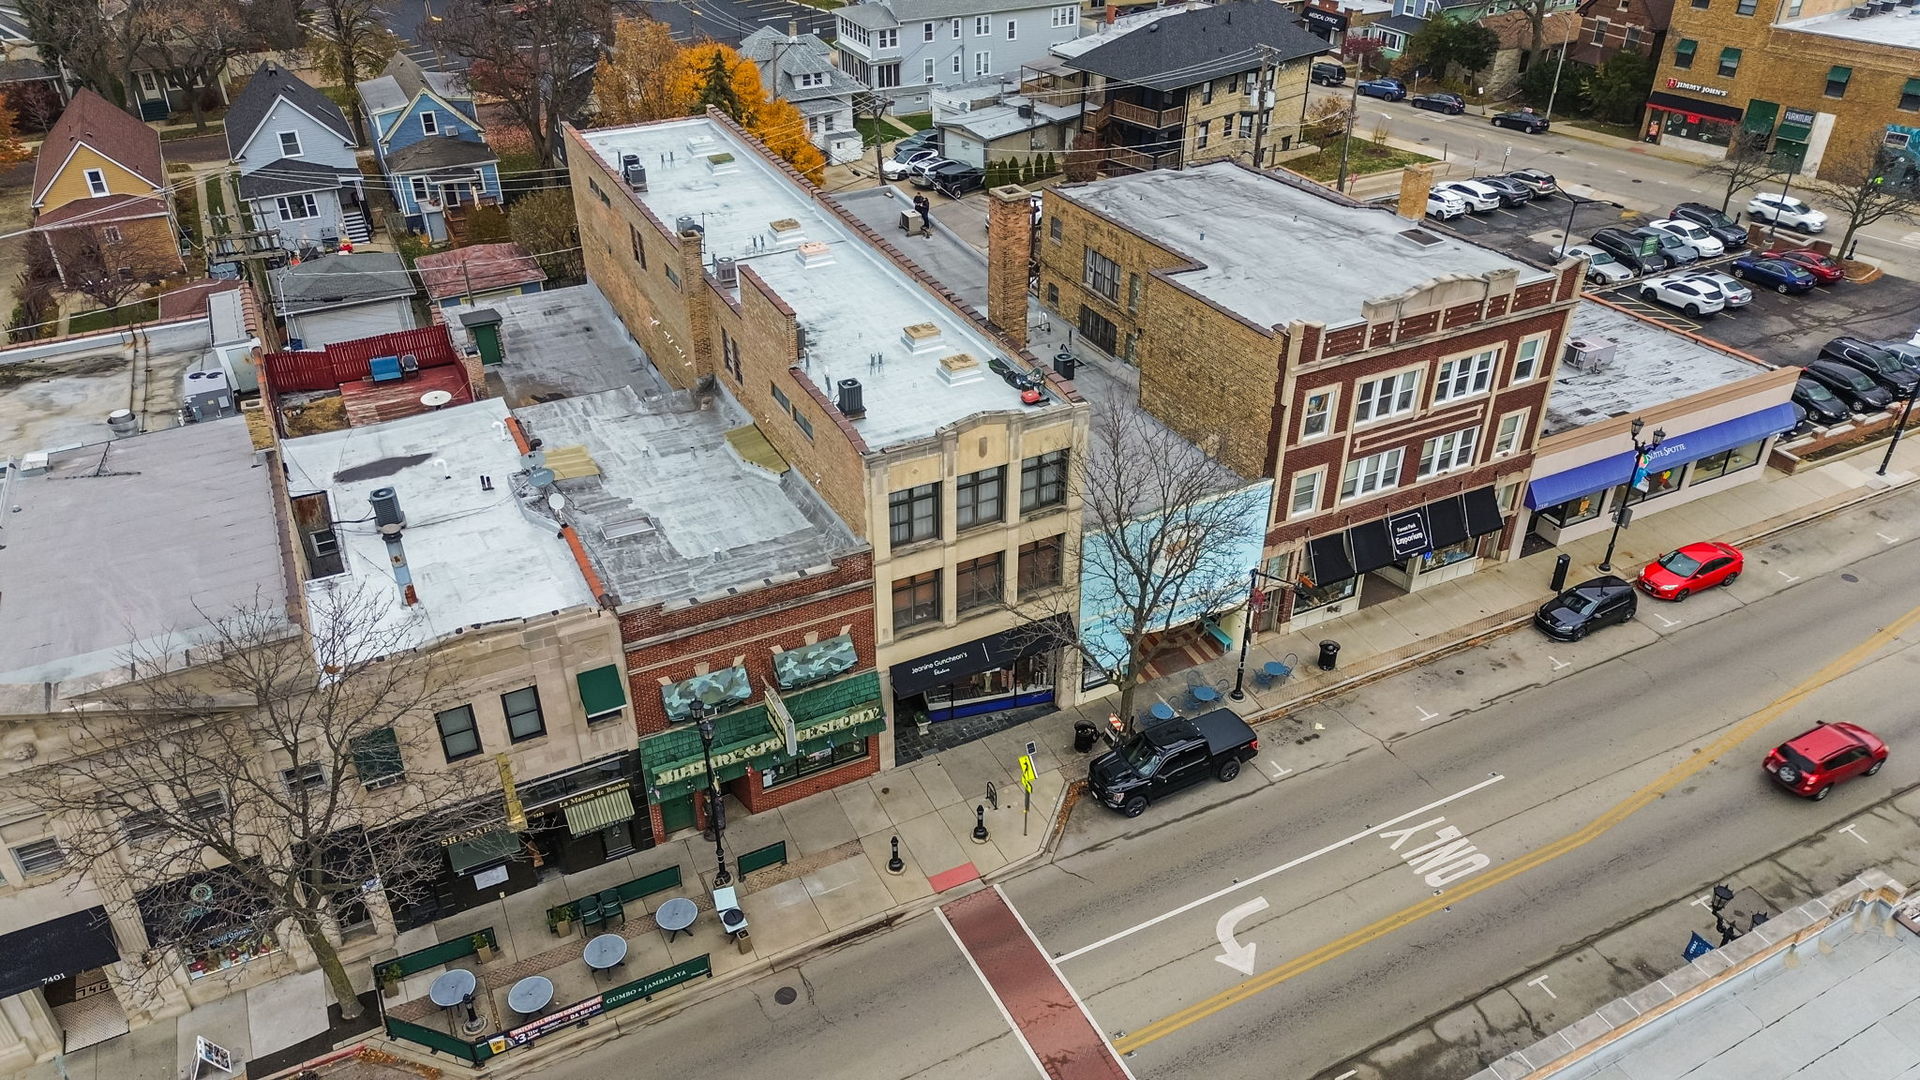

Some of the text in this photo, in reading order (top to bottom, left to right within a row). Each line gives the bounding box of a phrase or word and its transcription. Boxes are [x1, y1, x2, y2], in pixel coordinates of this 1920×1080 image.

[1677, 82, 1728, 96] JIMMY JOHN'S
[1785, 111, 1814, 123] FURNITURE
[1395, 532, 1423, 545] Emporium
[912, 652, 968, 674] Jeanine Guncheon's
[759, 727, 818, 754] POCE
[560, 798, 568, 807] La
[570, 793, 595, 804] Maison
[606, 782, 630, 793] Bonbon
[1379, 816, 1490, 887] ONLY
[41, 972, 67, 984] 7401
[606, 988, 637, 1004] GUMBO
[644, 970, 687, 992] JAMBALAYA
